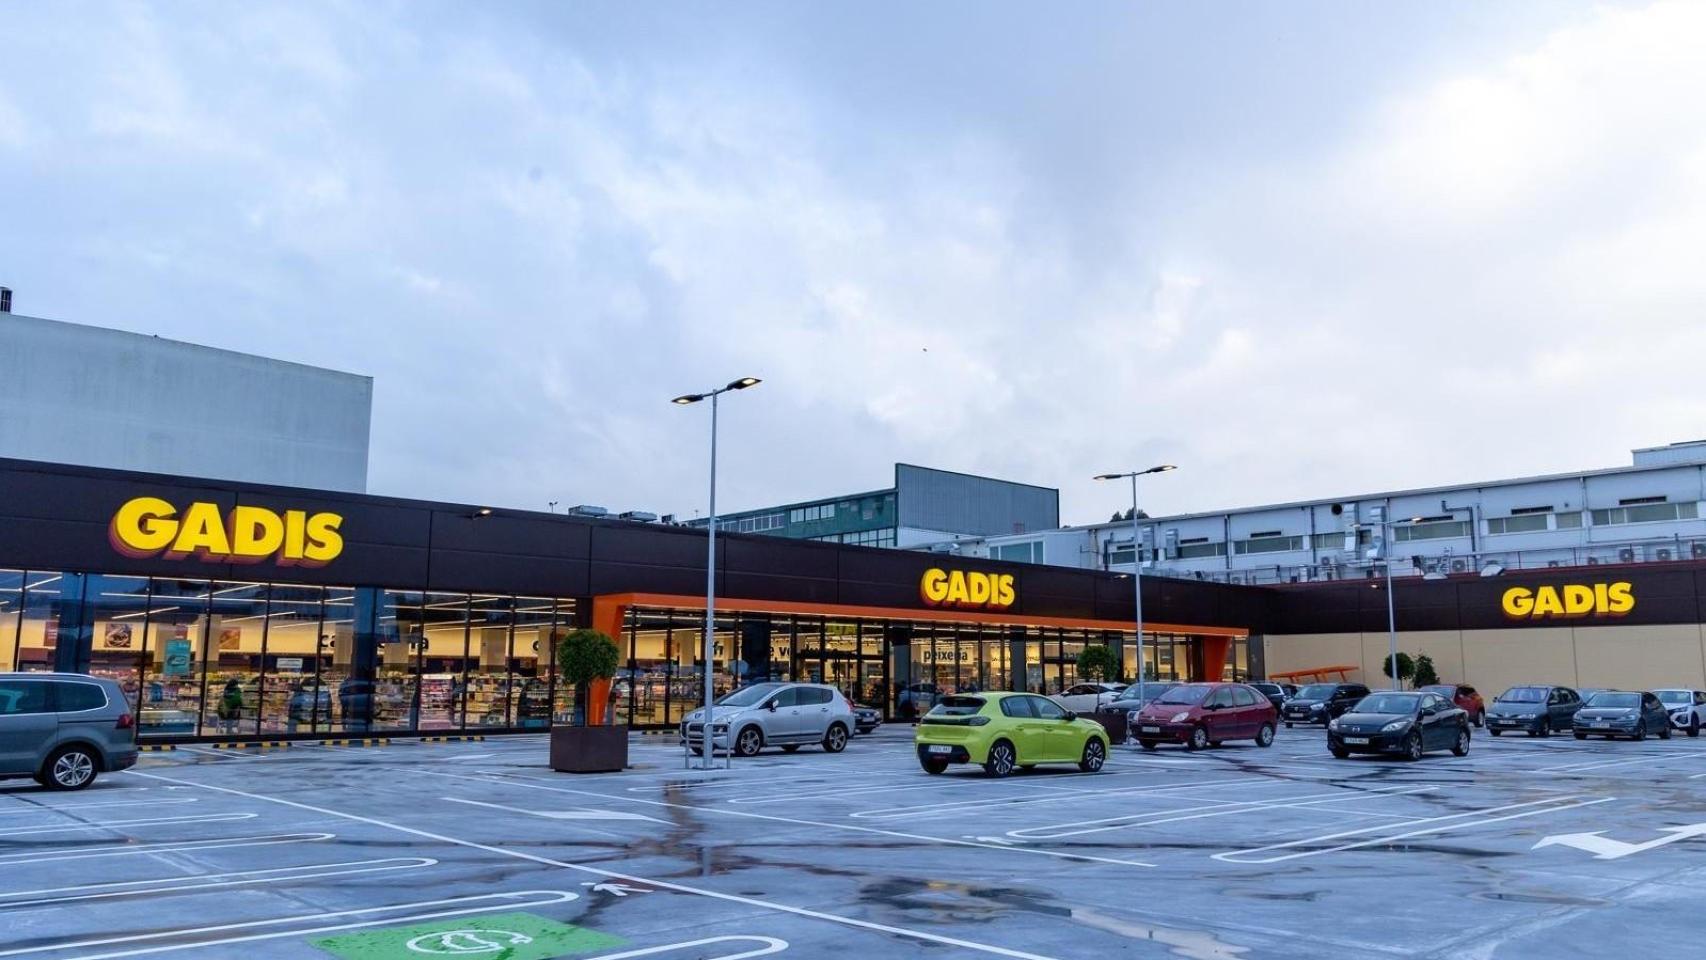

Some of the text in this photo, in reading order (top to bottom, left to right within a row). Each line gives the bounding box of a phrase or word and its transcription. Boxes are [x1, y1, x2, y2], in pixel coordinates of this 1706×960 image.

[114, 496, 344, 563] GADIS
[922, 568, 1016, 608] GADIS
[1501, 581, 1636, 618] GADIS
[924, 648, 968, 662] pixea
